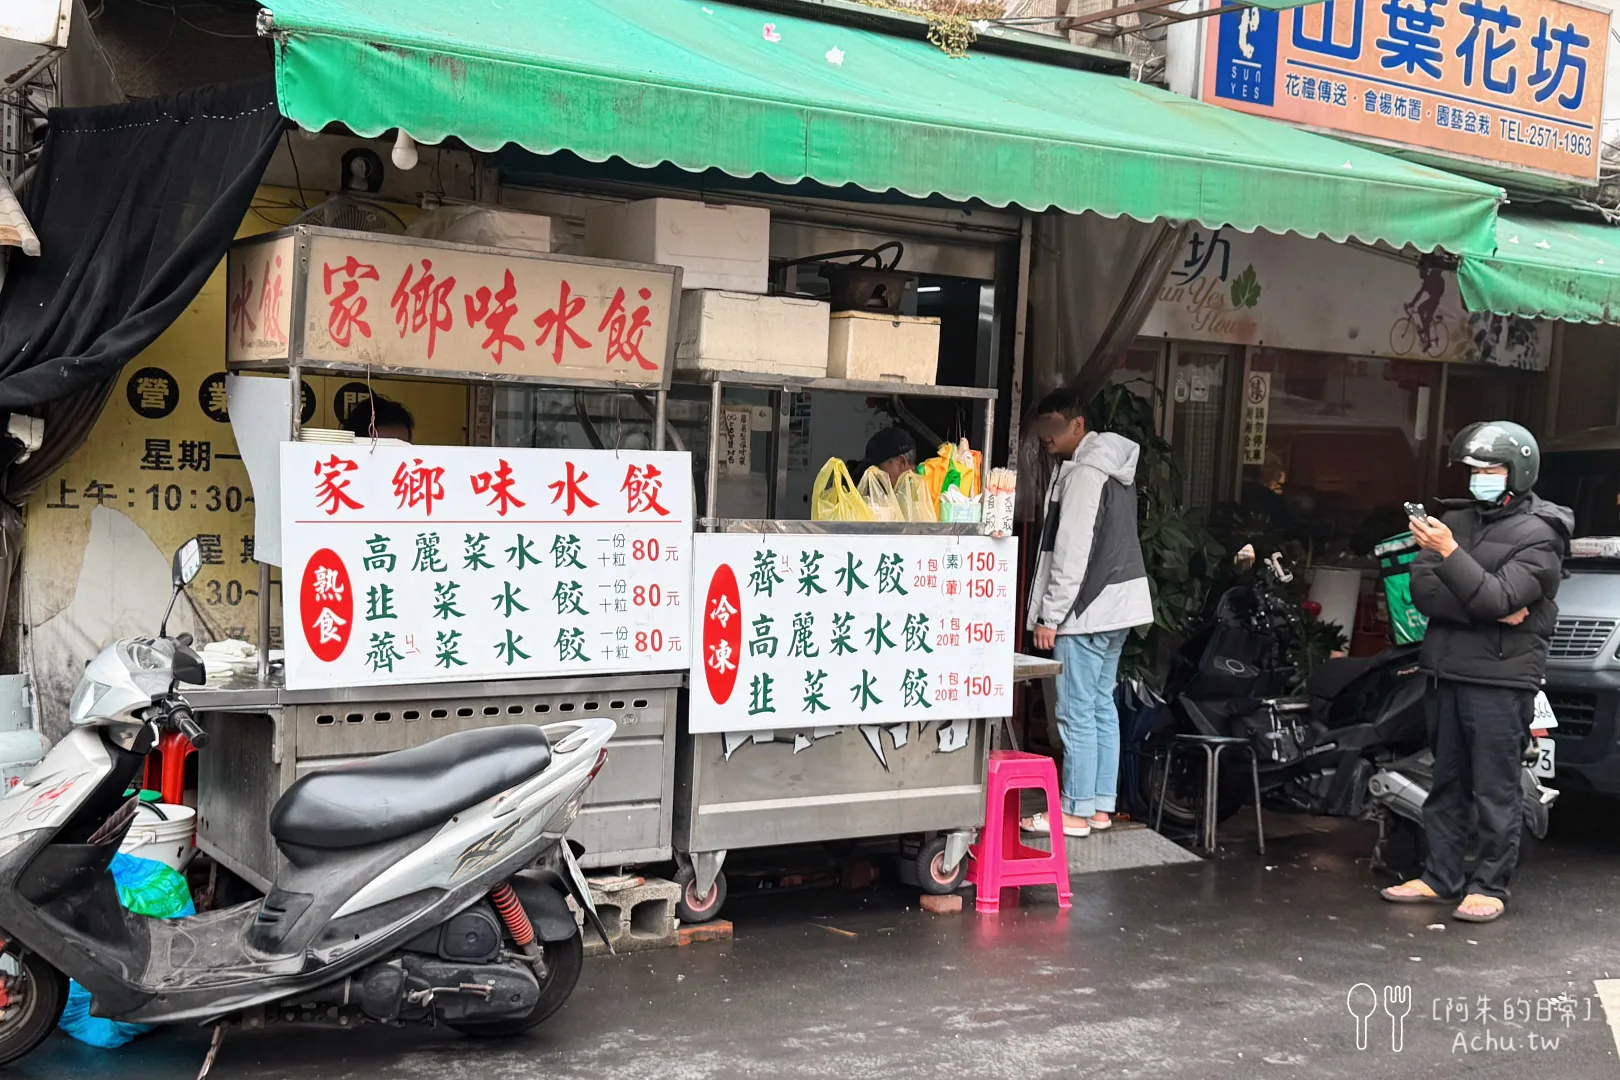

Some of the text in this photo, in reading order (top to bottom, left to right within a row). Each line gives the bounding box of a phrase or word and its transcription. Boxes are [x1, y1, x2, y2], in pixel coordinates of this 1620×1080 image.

[1291, 0, 1592, 111] 山葉花坊
[1230, 82, 1261, 100] YES
[1499, 118, 1592, 157] TEL:2571-1963
[232, 254, 289, 350] 水餃
[323, 256, 659, 370] 家鄉味水餃
[314, 453, 671, 517] 家鄉味水餃
[362, 532, 588, 573] 高麗菜水餃
[597, 533, 626, 549] 一份
[597, 552, 627, 567] 十粒
[747, 549, 909, 598] 薺菜水餃
[312, 565, 347, 644] 熟食
[365, 580, 590, 621] 韭菜水餃
[599, 578, 627, 594] 一份
[599, 597, 628, 613] 十粒
[364, 626, 591, 674] 薺菜水餃
[600, 626, 629, 642] 一份
[600, 645, 630, 660] 十粒
[708, 594, 738, 674] 冷凍
[748, 611, 934, 659] 高麗菜水餃
[748, 668, 933, 716] 韭菜水餃
